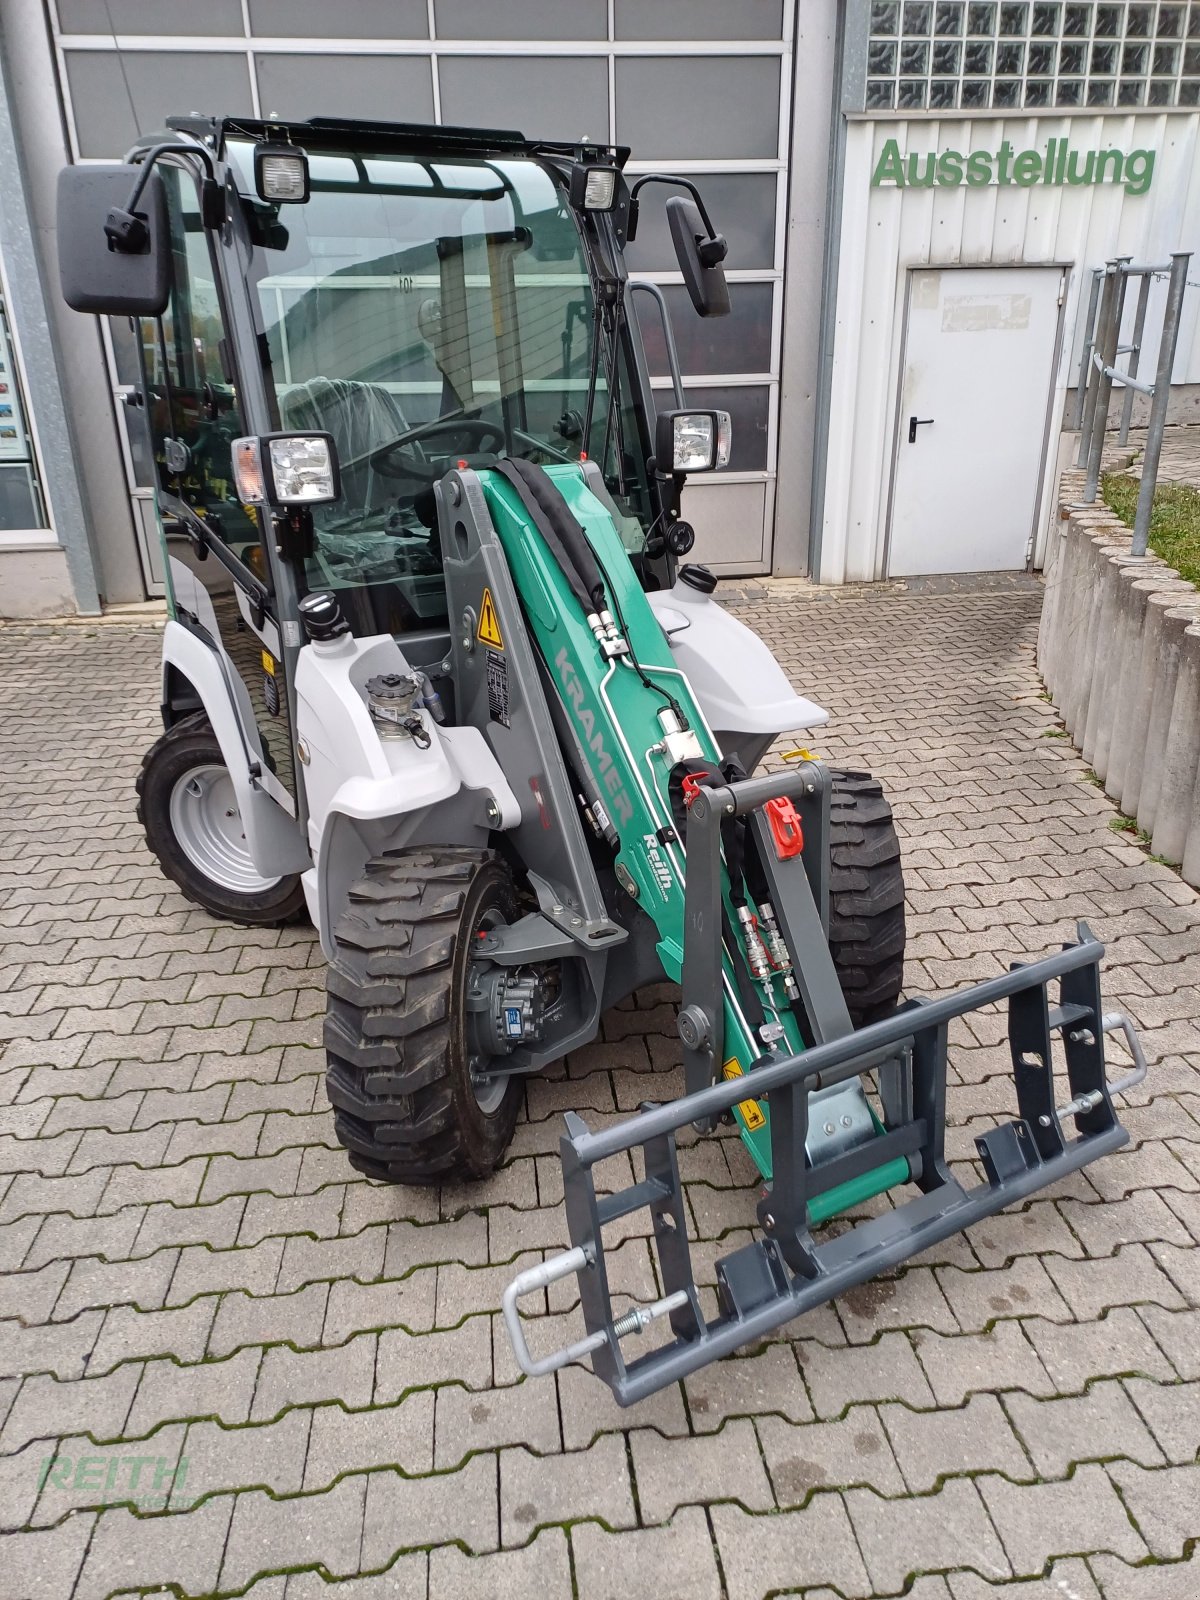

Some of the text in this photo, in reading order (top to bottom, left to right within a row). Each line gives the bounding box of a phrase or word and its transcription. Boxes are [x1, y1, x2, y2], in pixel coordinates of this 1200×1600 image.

[871, 137, 1156, 195] Ausstellung
[554, 647, 636, 827] KRAMER
[643, 833, 672, 890] Reith
